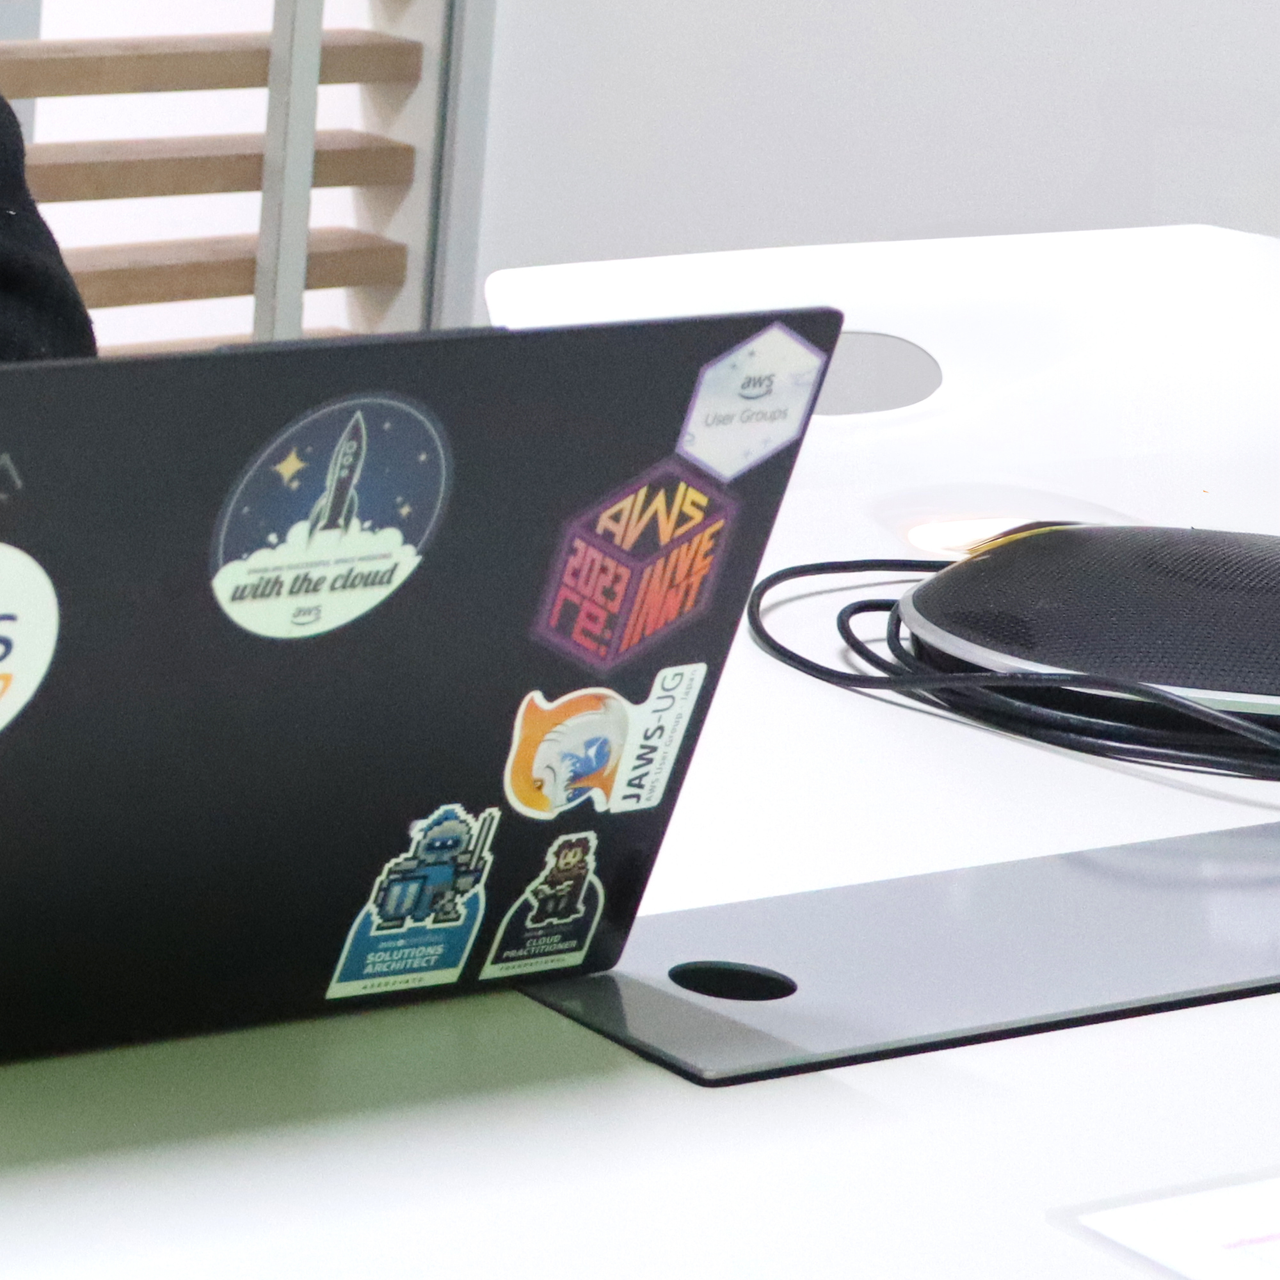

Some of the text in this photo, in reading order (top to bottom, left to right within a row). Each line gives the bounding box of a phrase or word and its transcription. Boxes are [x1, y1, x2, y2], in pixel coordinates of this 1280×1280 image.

[741, 373, 775, 390] aws
[705, 408, 789, 427] User Groups
[595, 481, 709, 551] AWS
[231, 563, 400, 602] with the cloud
[292, 604, 322, 619] aws
[621, 671, 685, 804] JAWS-UG
[502, 940, 578, 958] PRACTITIONER
[526, 935, 562, 947] CLOUD
[366, 944, 445, 963] SOLUTIONS
[363, 955, 439, 974] ARCHITECT
